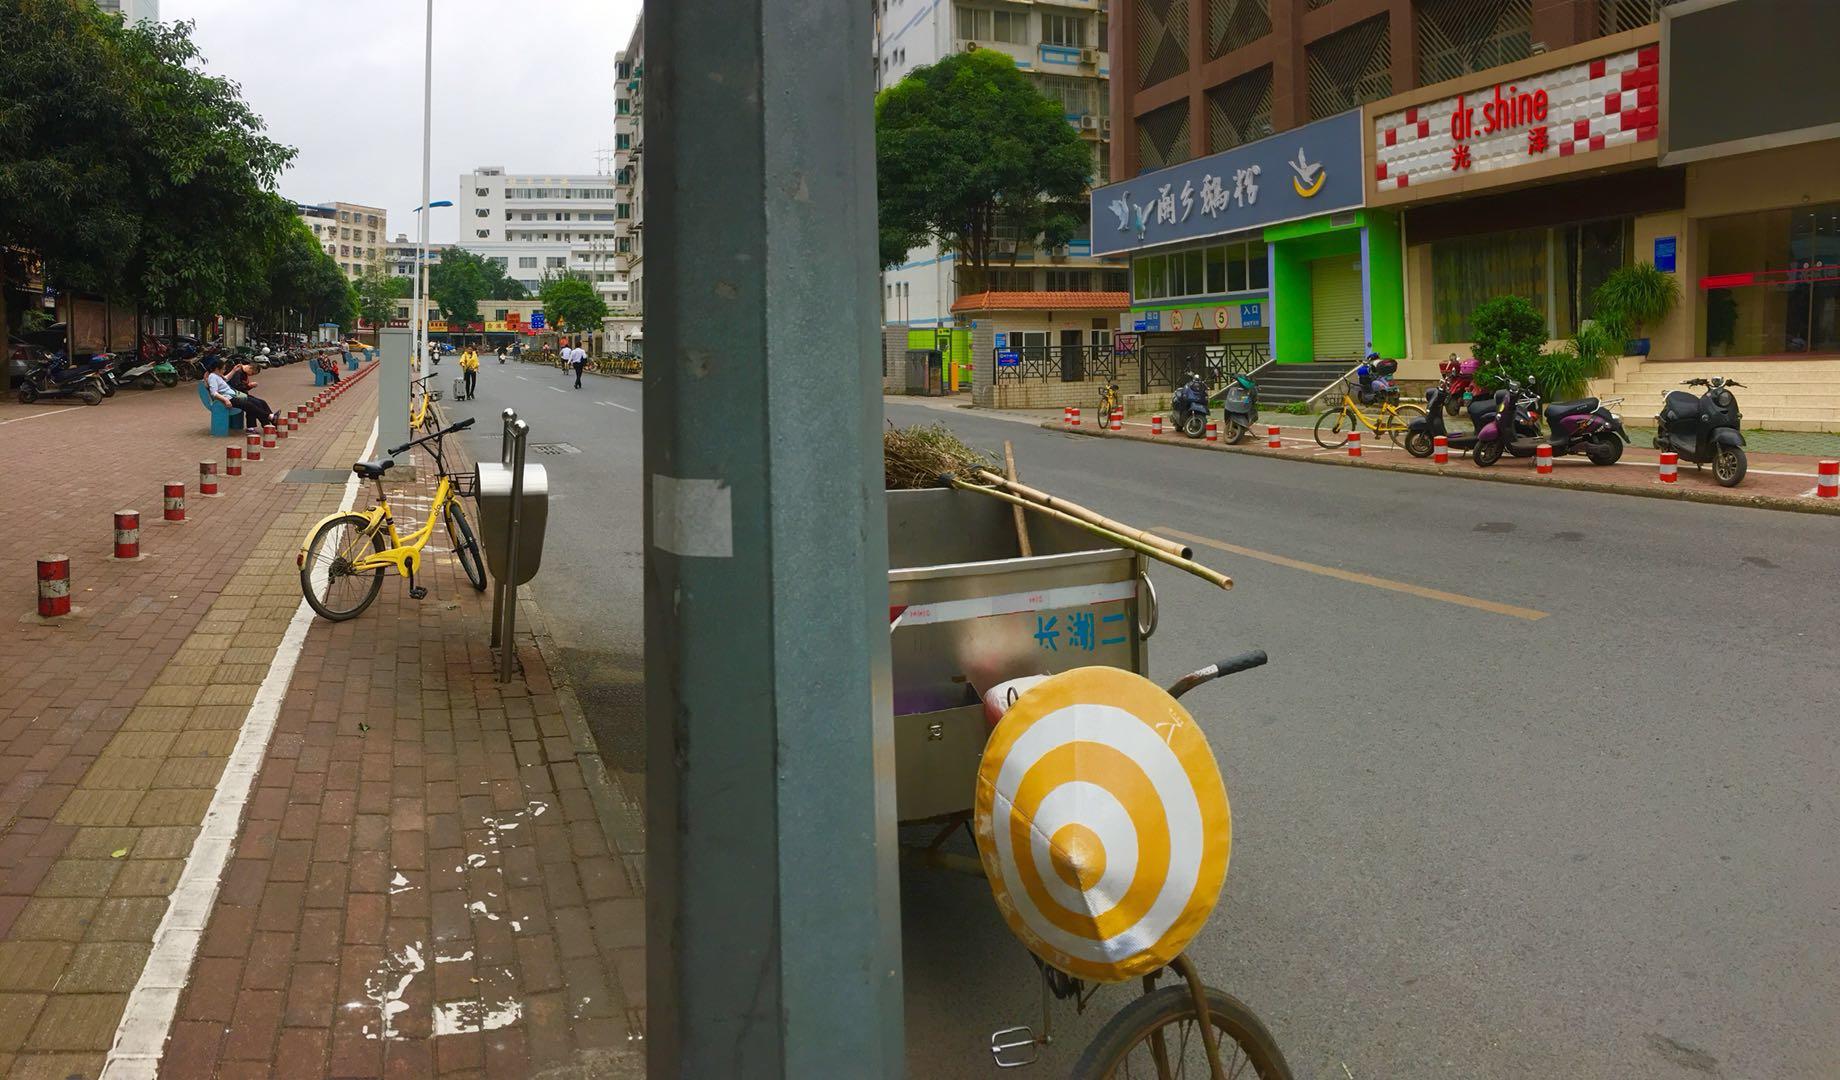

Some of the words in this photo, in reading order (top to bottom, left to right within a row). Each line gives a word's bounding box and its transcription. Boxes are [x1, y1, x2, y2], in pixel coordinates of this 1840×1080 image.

[1451, 84, 1548, 141] dr.shine
[1243, 305, 1259, 315] 入口
[1218, 312, 1225, 324] 5
